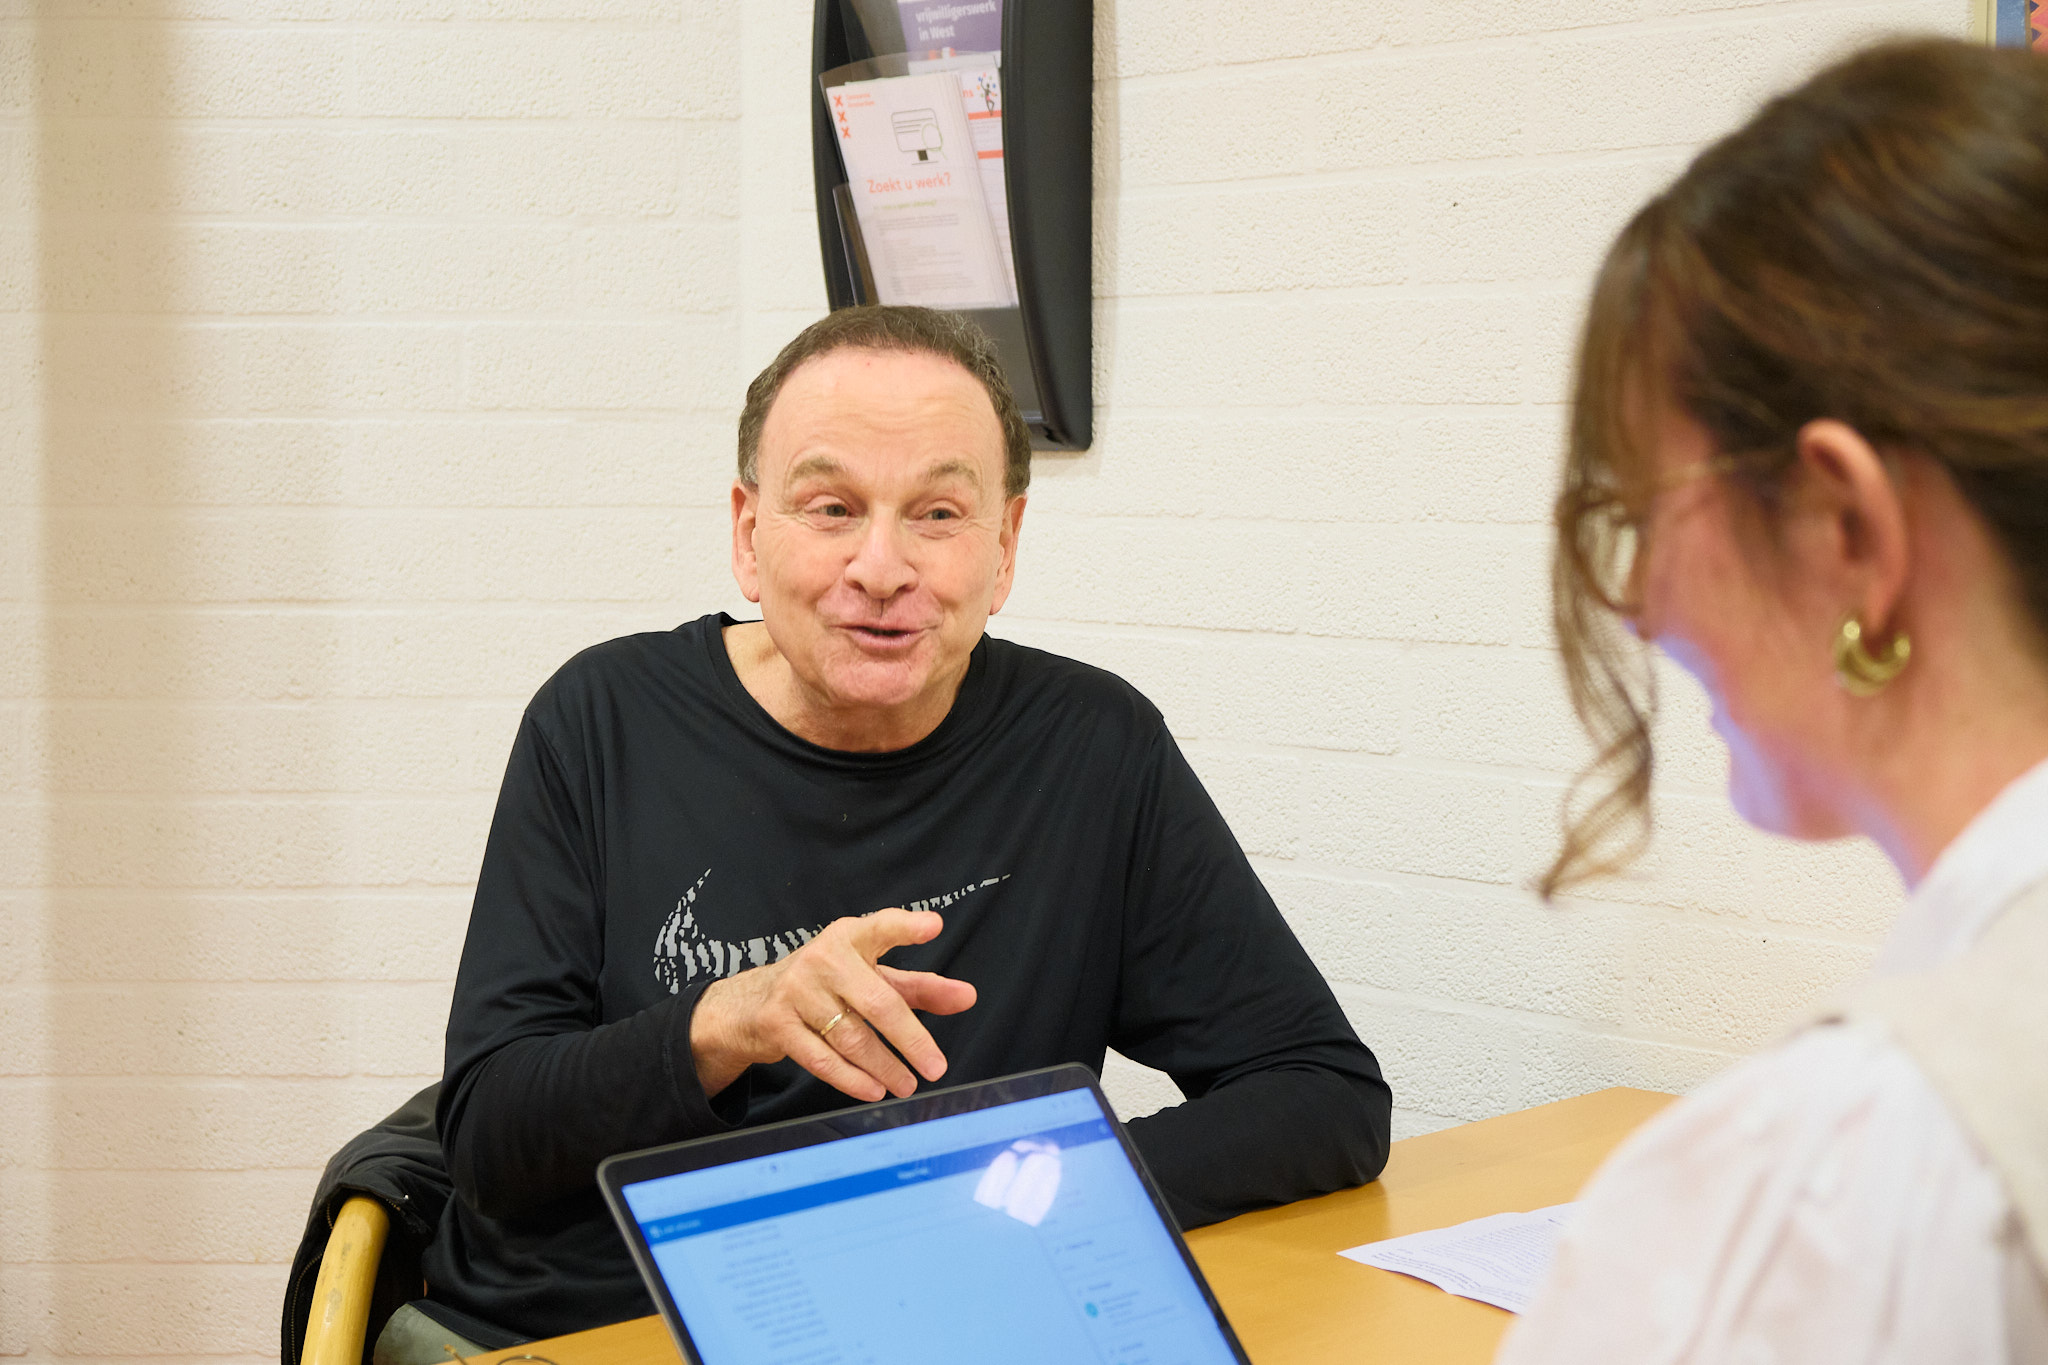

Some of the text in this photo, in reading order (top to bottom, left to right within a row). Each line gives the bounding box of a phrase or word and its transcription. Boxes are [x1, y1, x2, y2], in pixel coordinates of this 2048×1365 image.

[915, 0, 997, 24] vrijwilligerswerk
[918, 25, 955, 41] in West
[866, 171, 952, 193] Zoekt u werk?
